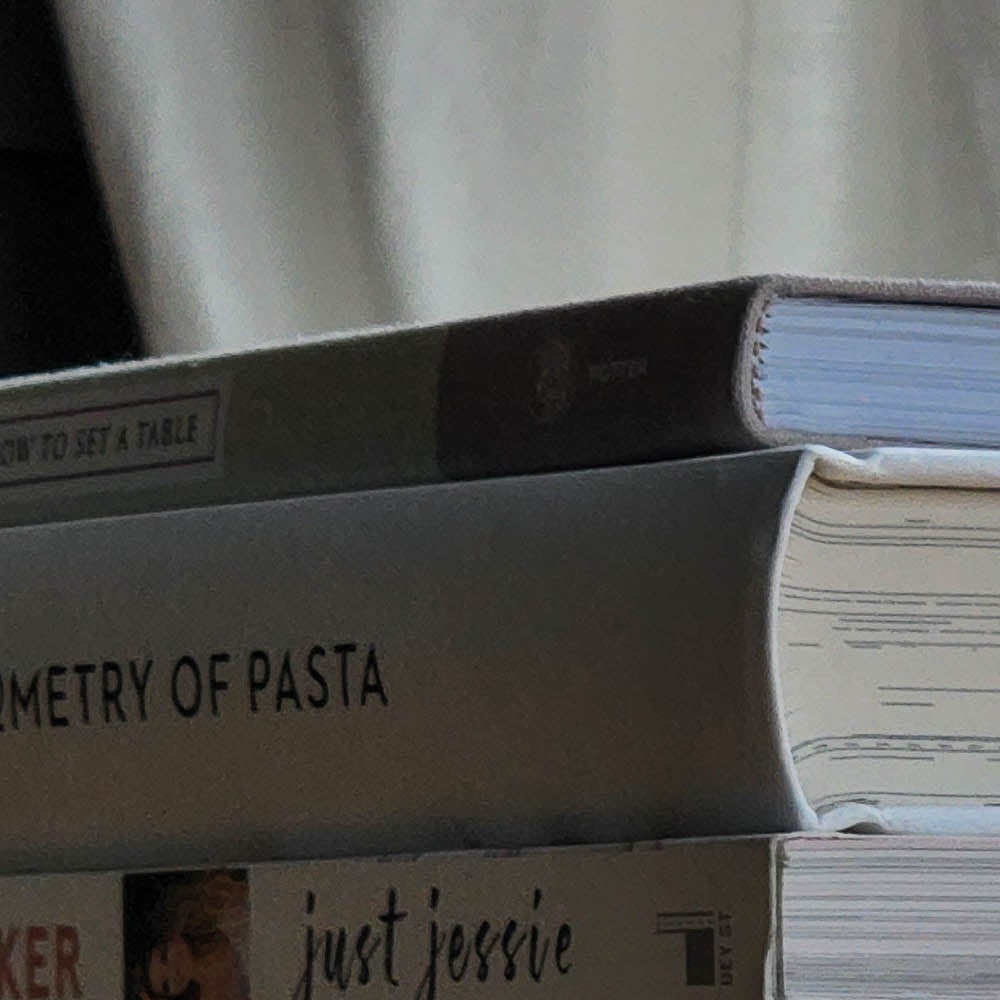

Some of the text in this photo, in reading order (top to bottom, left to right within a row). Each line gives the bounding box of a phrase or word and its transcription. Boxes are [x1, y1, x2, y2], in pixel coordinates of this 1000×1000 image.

[117, 424, 129, 452] A
[138, 414, 198, 449] TABLE
[0, 643, 389, 732] METRY OF PASTA
[719, 946, 733, 986] DEY
